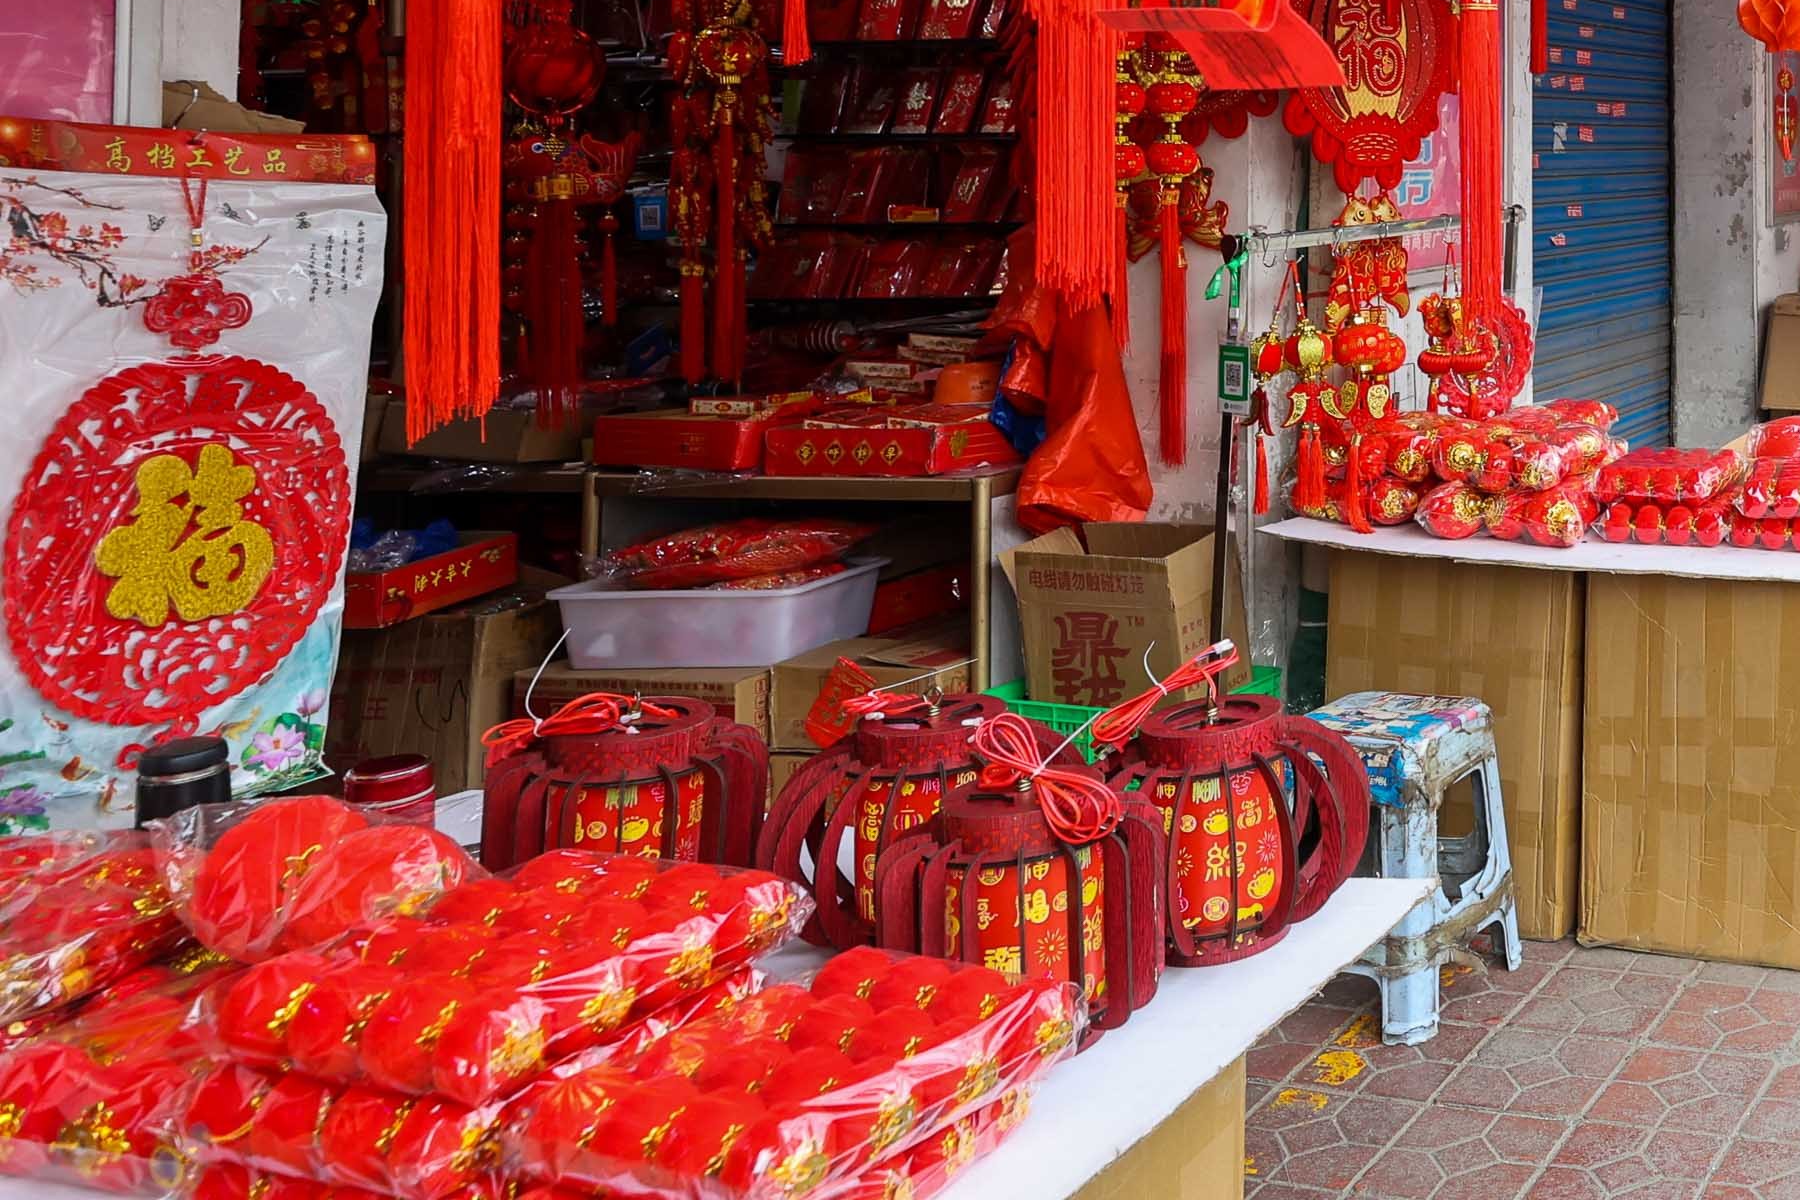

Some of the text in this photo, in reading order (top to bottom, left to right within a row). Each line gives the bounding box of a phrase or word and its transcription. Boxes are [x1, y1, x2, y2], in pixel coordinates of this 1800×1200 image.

[103, 135, 289, 177] 高档工艺品
[96, 444, 274, 627] 福
